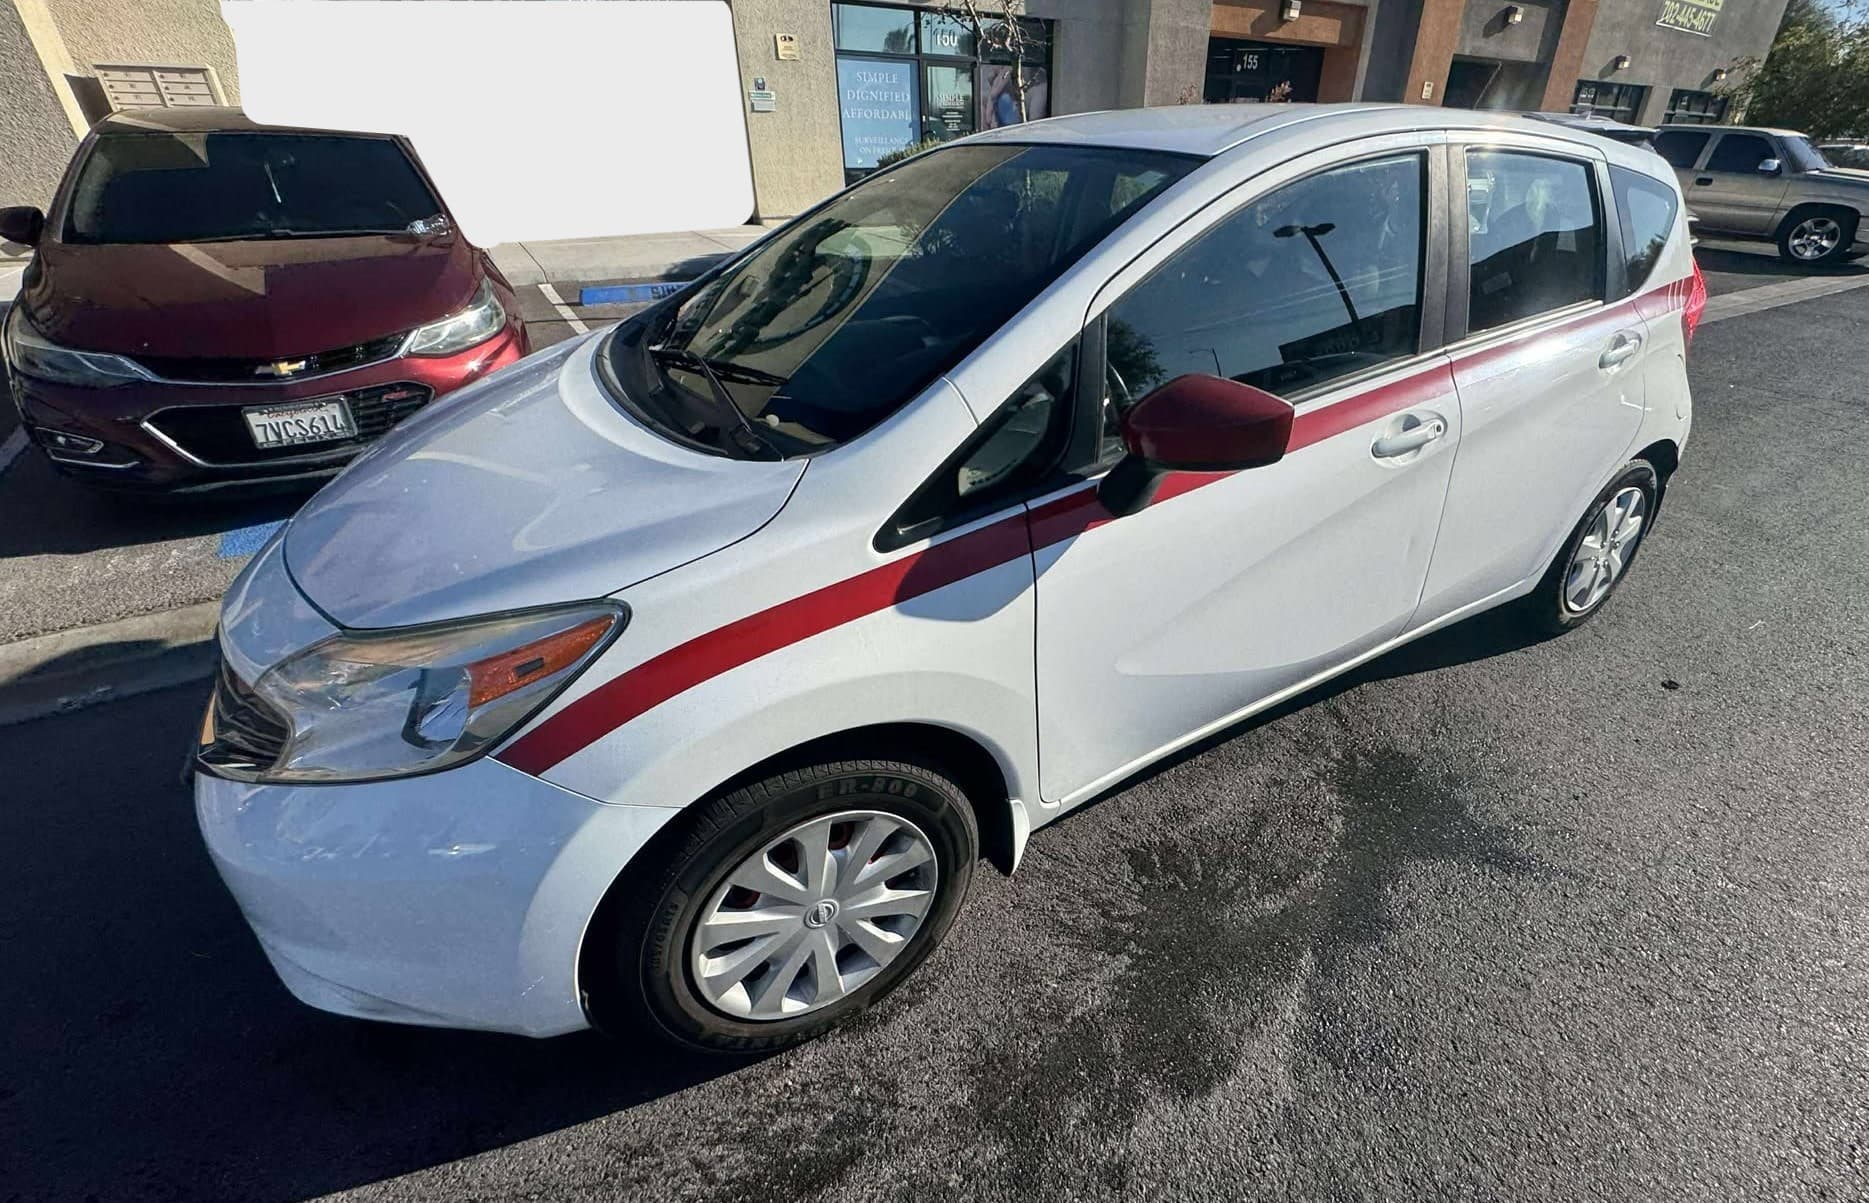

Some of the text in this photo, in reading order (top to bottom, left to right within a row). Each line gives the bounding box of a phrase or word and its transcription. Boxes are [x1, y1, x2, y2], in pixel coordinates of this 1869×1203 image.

[1242, 53, 1259, 70] 155
[856, 71, 898, 84] SIMPLE
[847, 89, 911, 103] DIGNIFIED
[843, 107, 912, 121] AFFORDABL
[255, 415, 346, 443] 7VCS614
